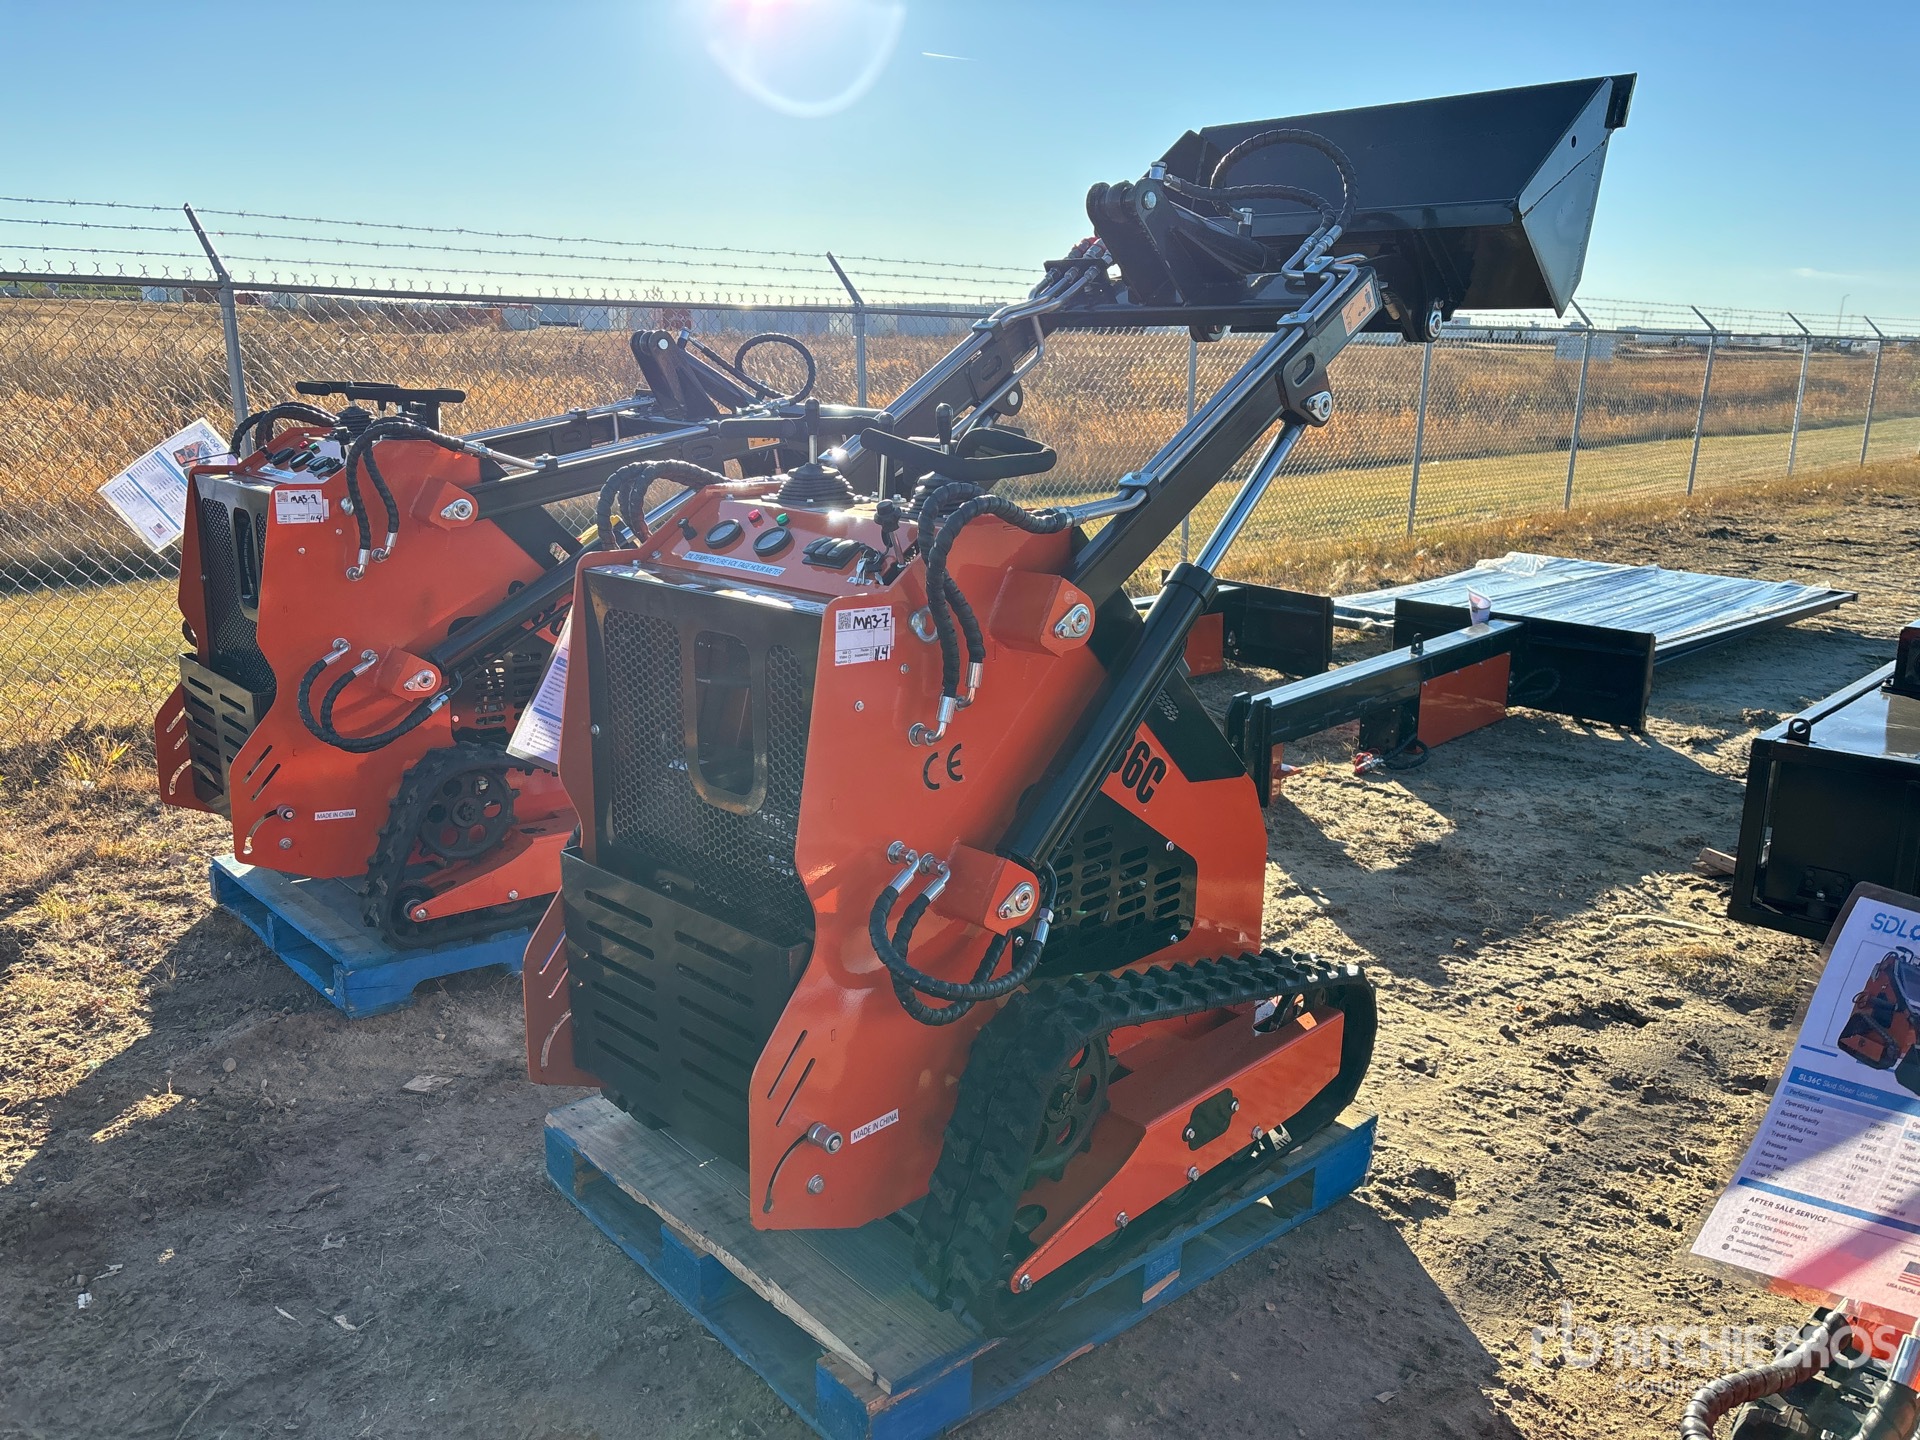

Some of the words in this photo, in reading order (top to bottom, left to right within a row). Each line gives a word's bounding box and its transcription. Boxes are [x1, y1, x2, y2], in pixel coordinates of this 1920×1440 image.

[694, 554, 728, 566] TEMPERATURE
[766, 566, 782, 574] METER
[853, 612, 889, 630] MA3-7
[922, 743, 963, 791] CE
[1789, 1088, 1820, 1102] Performance
[1798, 1073, 1822, 1086] SL36C
[1856, 1088, 1879, 1100] Loader
[1784, 1099, 1810, 1112] Operating
[1810, 1105, 1823, 1114] Load
[853, 1124, 872, 1140] MADE
[872, 1122, 878, 1130] IN
[880, 1113, 898, 1127] CHINA
[1780, 1110, 1798, 1119] Bucket
[1798, 1114, 1819, 1126] Capacity
[1776, 1120, 1786, 1128] Max
[1804, 1127, 1818, 1136] Force
[1787, 1134, 1803, 1144] Speed
[1749, 1197, 1774, 1208] AFTER
[1775, 1203, 1795, 1214] SALE
[1795, 1209, 1828, 1223] SERVICE
[1755, 1223, 1772, 1232] STOCK
[1773, 1228, 1790, 1237] SPARE
[1790, 1232, 1808, 1242] PARTS
[1779, 1219, 1809, 1232] WARRANTY
